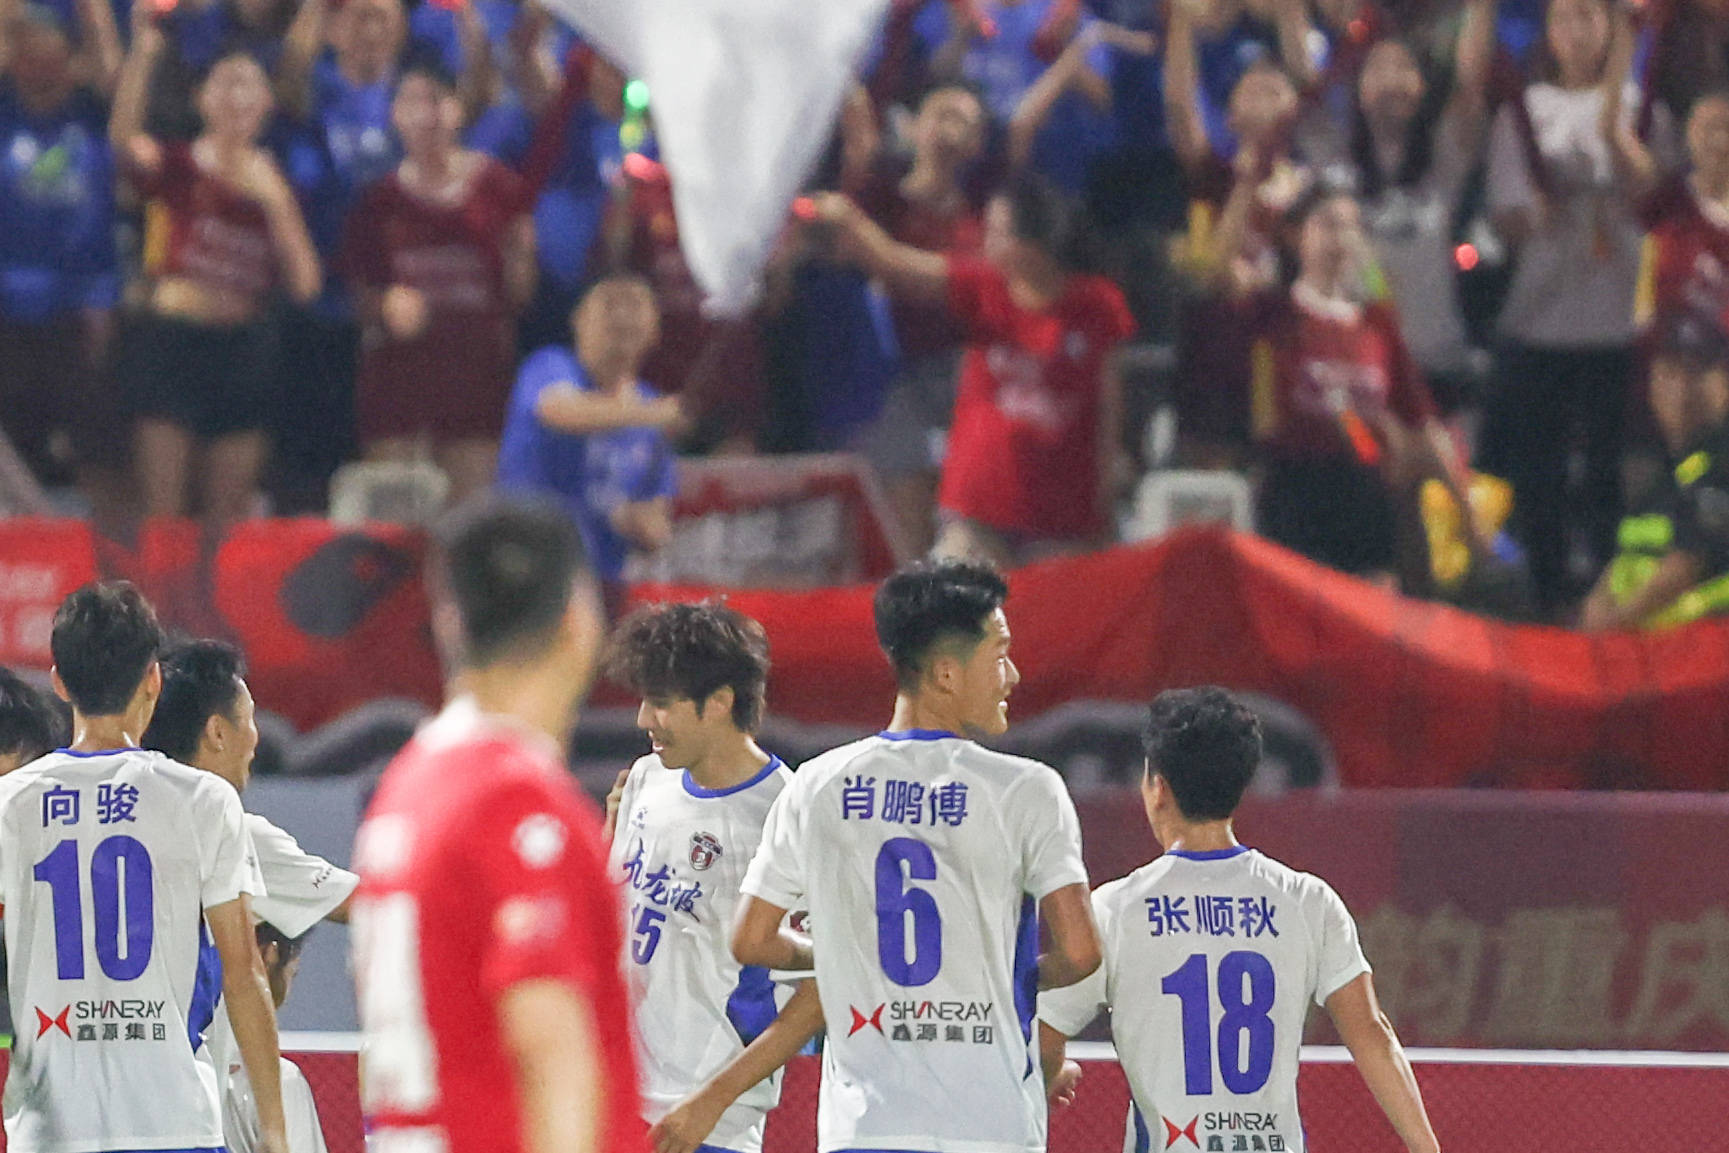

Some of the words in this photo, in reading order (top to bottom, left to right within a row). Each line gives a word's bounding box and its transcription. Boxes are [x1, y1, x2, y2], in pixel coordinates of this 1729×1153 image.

[42, 783, 140, 828] 向骏
[842, 774, 969, 827] 肖鹏博
[34, 834, 154, 982] 10
[875, 837, 942, 987] 6
[1145, 895, 1280, 939] 张顺秋
[75, 999, 166, 1019] SHINERAY
[890, 1000, 993, 1021] SHINERAY
[1161, 950, 1275, 1096] 18
